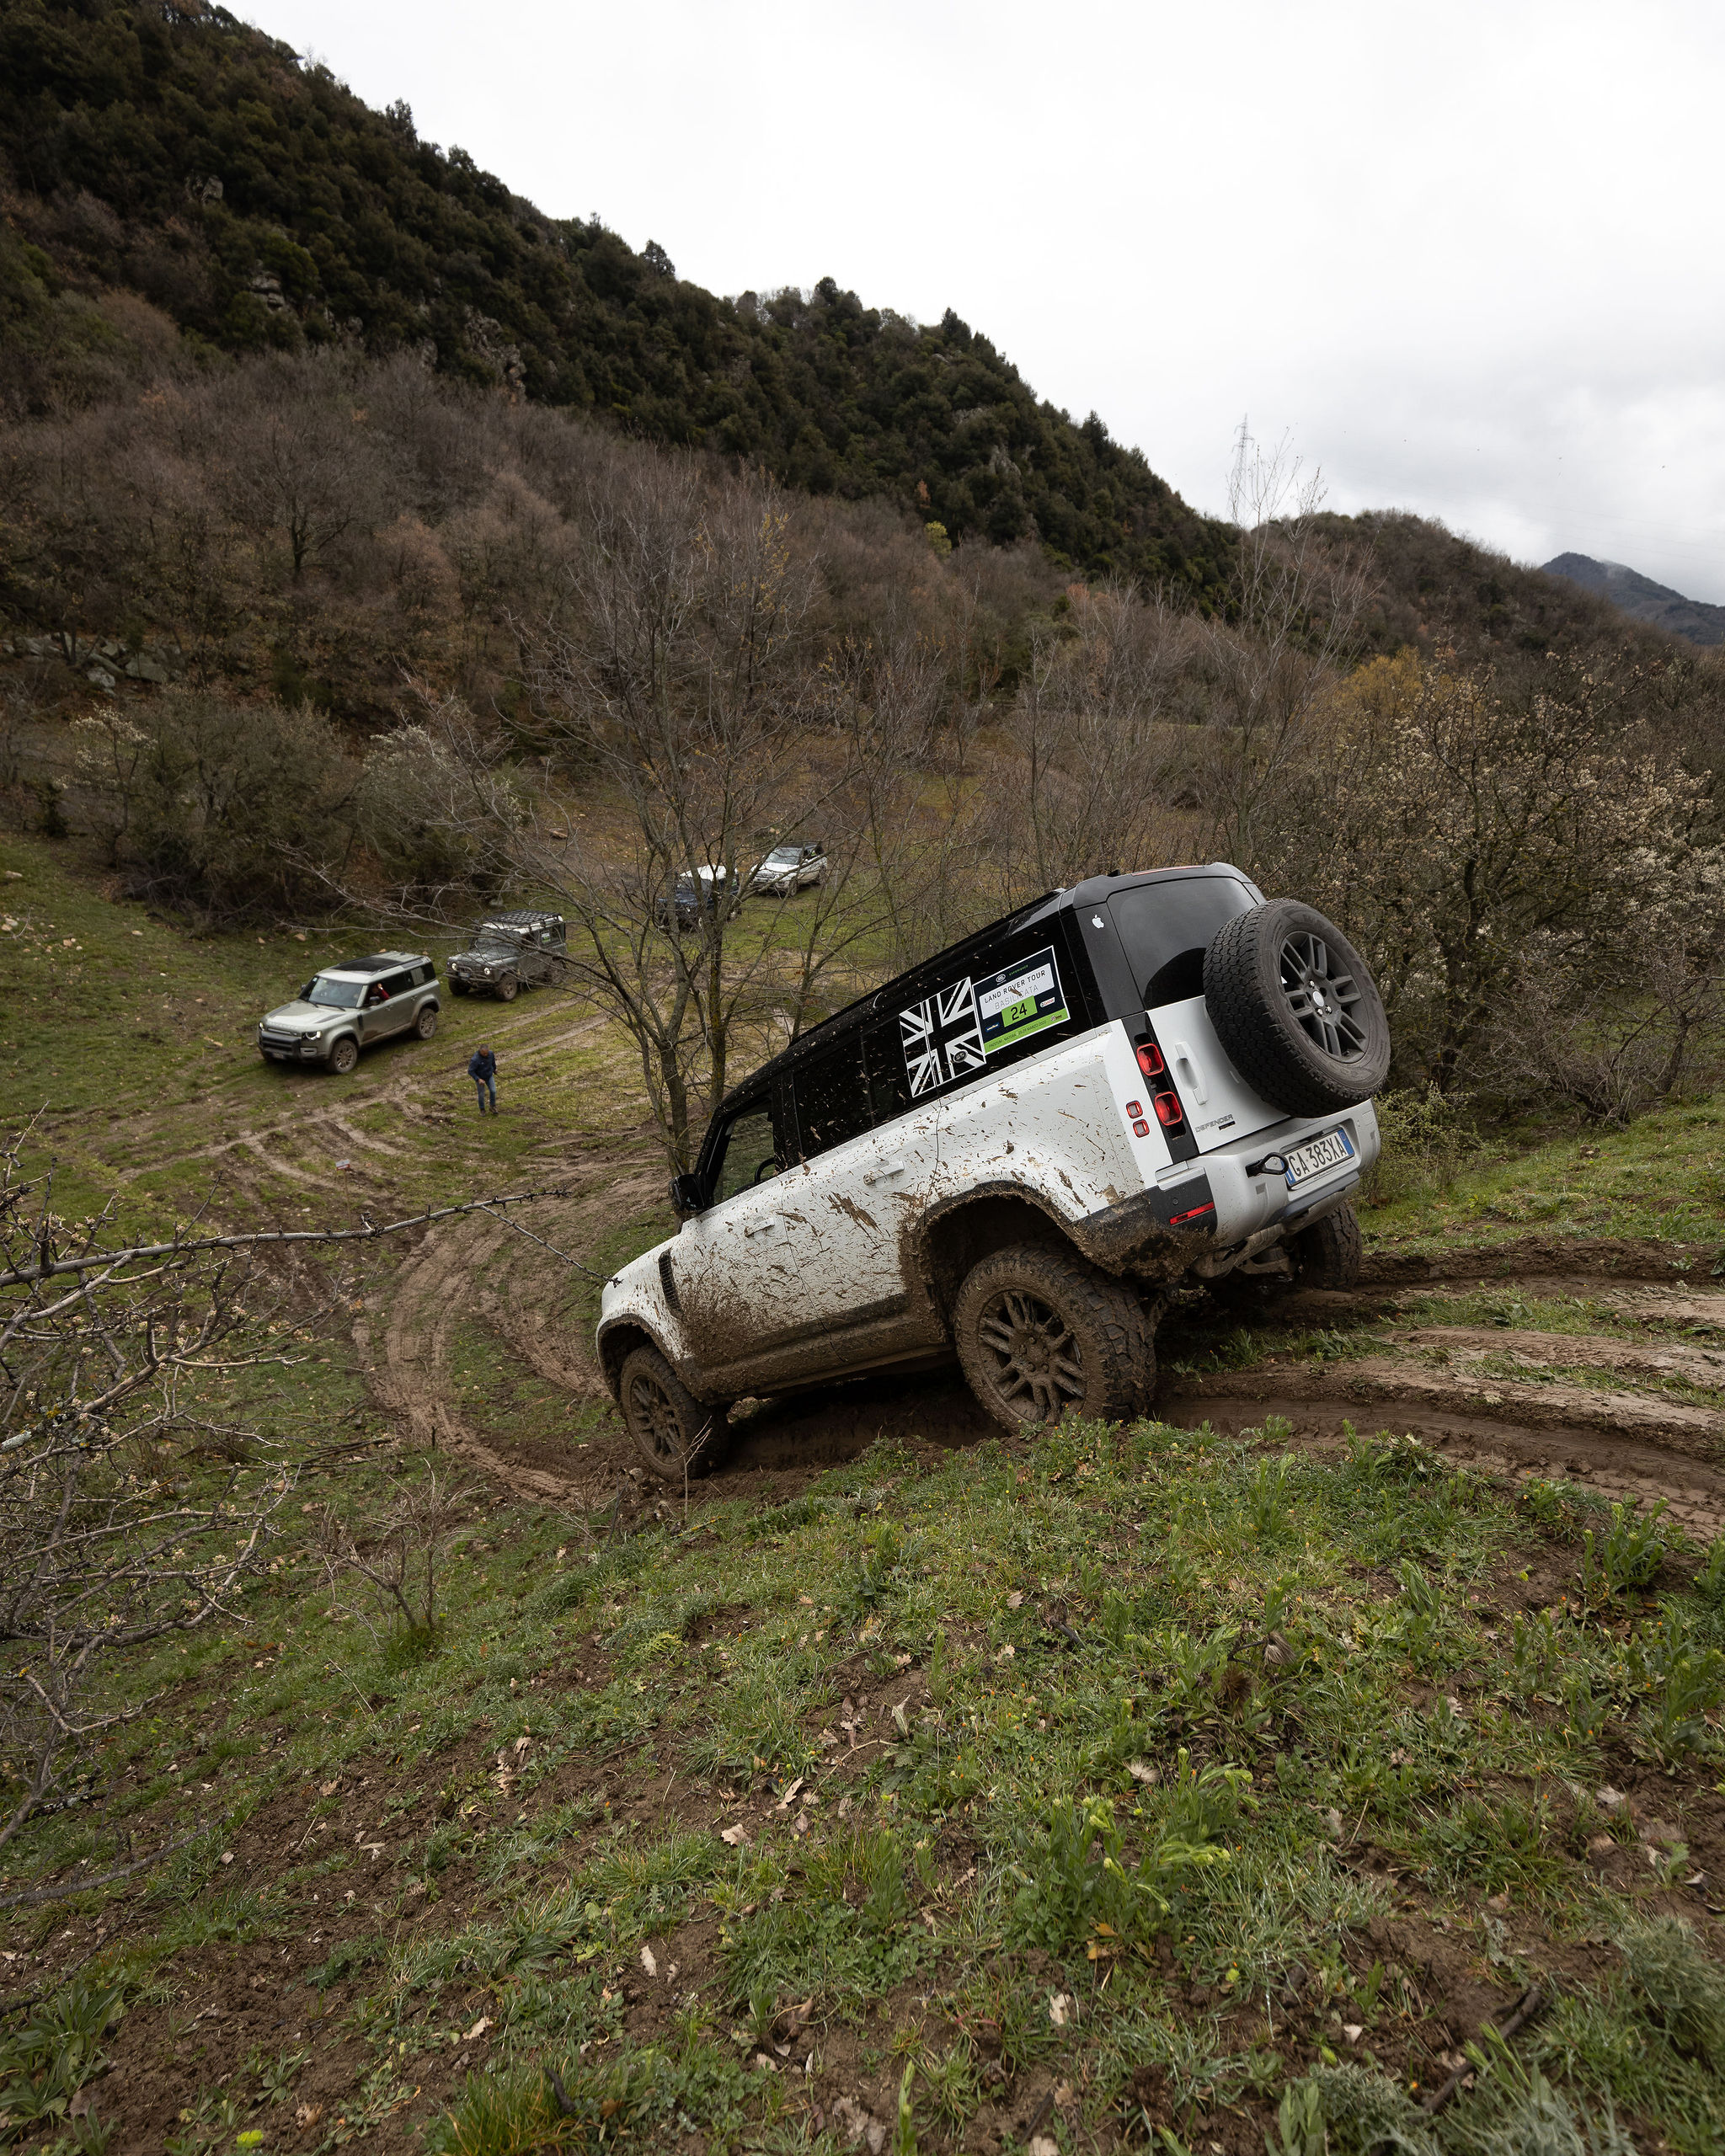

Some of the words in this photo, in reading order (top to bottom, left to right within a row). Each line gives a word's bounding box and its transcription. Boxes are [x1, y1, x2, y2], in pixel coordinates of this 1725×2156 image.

[984, 990, 1001, 1003] LAND
[1003, 980, 1025, 995] ROVER
[1027, 969, 1046, 983] TOUR
[1011, 1002, 1028, 1021] 24
[1194, 1113, 1234, 1133] DEFENDER
[1288, 1152, 1310, 1177] GA
[1306, 1135, 1347, 1168] 383XA
